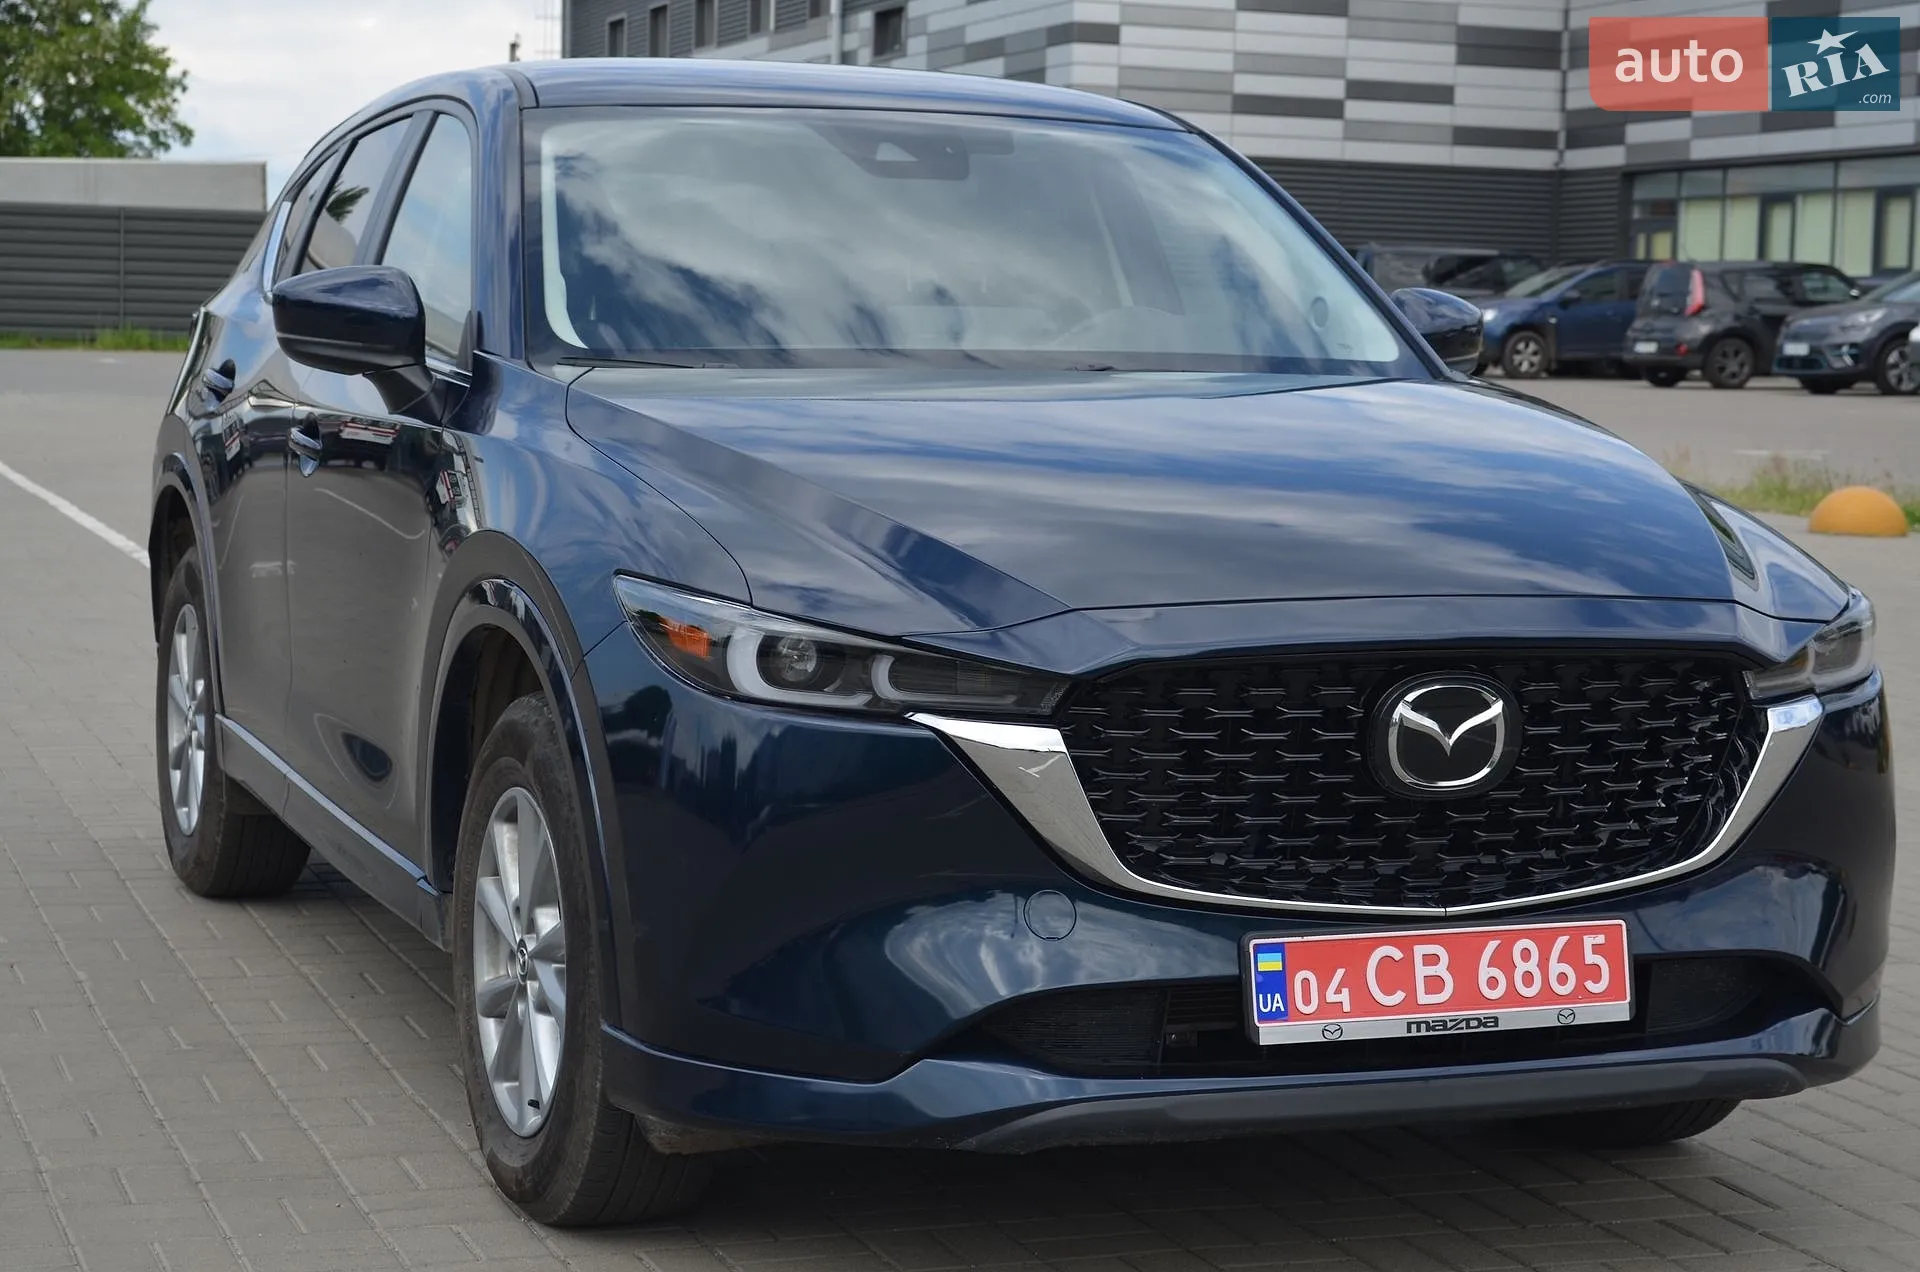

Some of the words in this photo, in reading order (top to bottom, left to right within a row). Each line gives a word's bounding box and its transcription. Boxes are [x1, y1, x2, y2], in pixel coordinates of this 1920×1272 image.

[1293, 967, 1351, 1015] 04
[1365, 944, 1455, 1007] CB
[1477, 934, 1610, 1000] 6865
[1258, 993, 1285, 1013] UA
